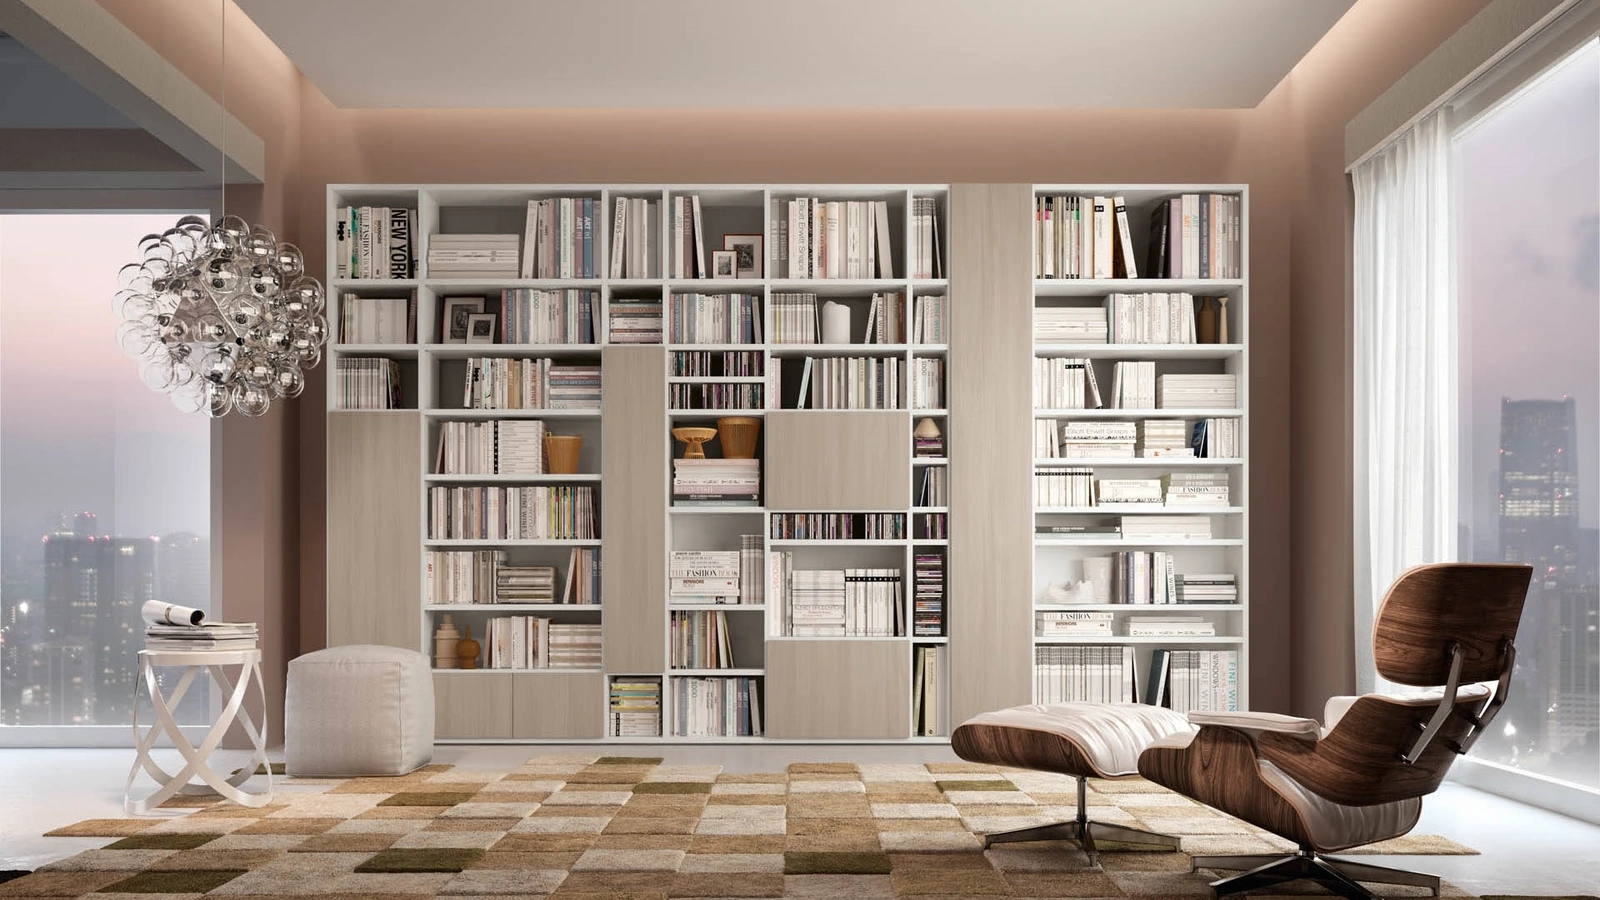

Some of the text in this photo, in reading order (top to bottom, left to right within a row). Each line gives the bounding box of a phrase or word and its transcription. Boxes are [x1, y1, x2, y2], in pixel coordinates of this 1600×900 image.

[615, 199, 625, 234] WINDOWS
[391, 210, 407, 279] NEW YORK
[798, 246, 806, 271] Snaps
[686, 569, 717, 577] FASHION
[1228, 662, 1236, 685] FINE
